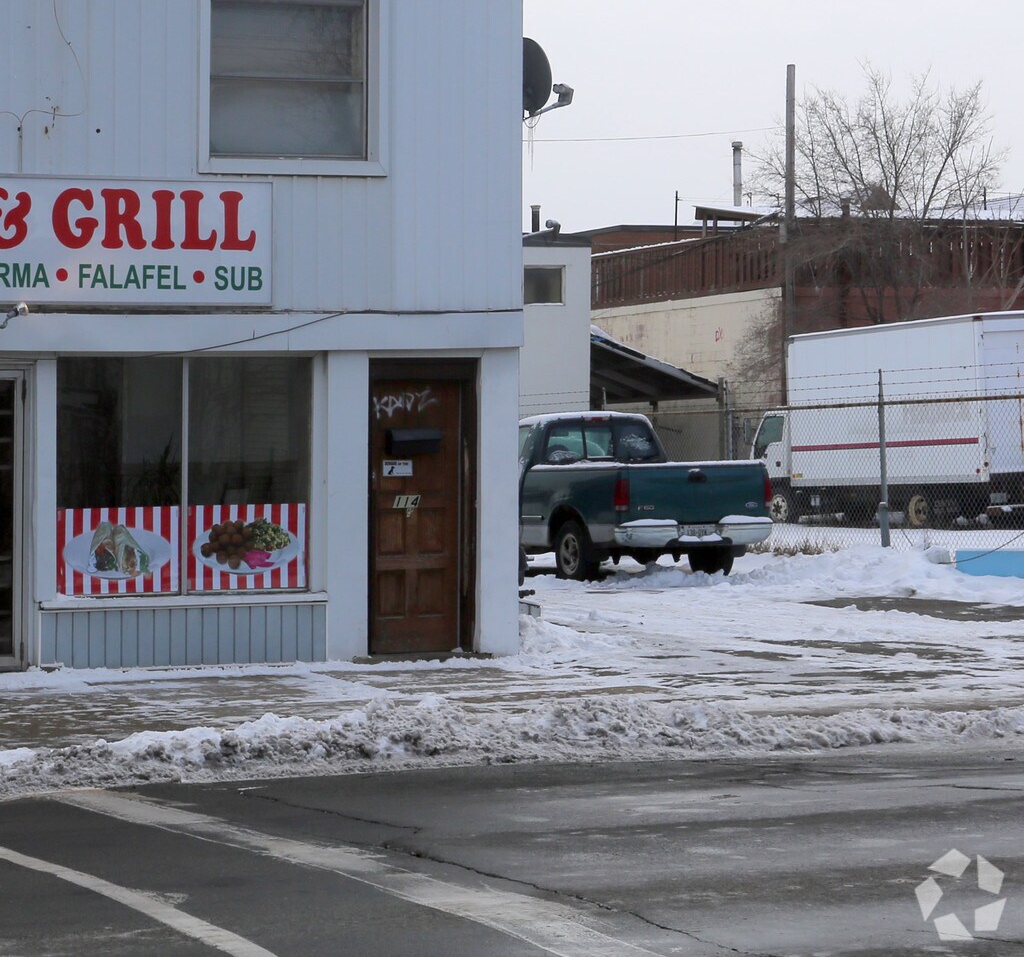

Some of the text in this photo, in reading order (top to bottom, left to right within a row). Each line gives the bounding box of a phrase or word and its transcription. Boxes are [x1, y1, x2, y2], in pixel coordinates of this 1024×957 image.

[51, 187, 257, 252] GRILL
[79, 264, 187, 290] FALAFEL
[214, 266, 263, 291] SUB
[396, 495, 420, 507] 114
